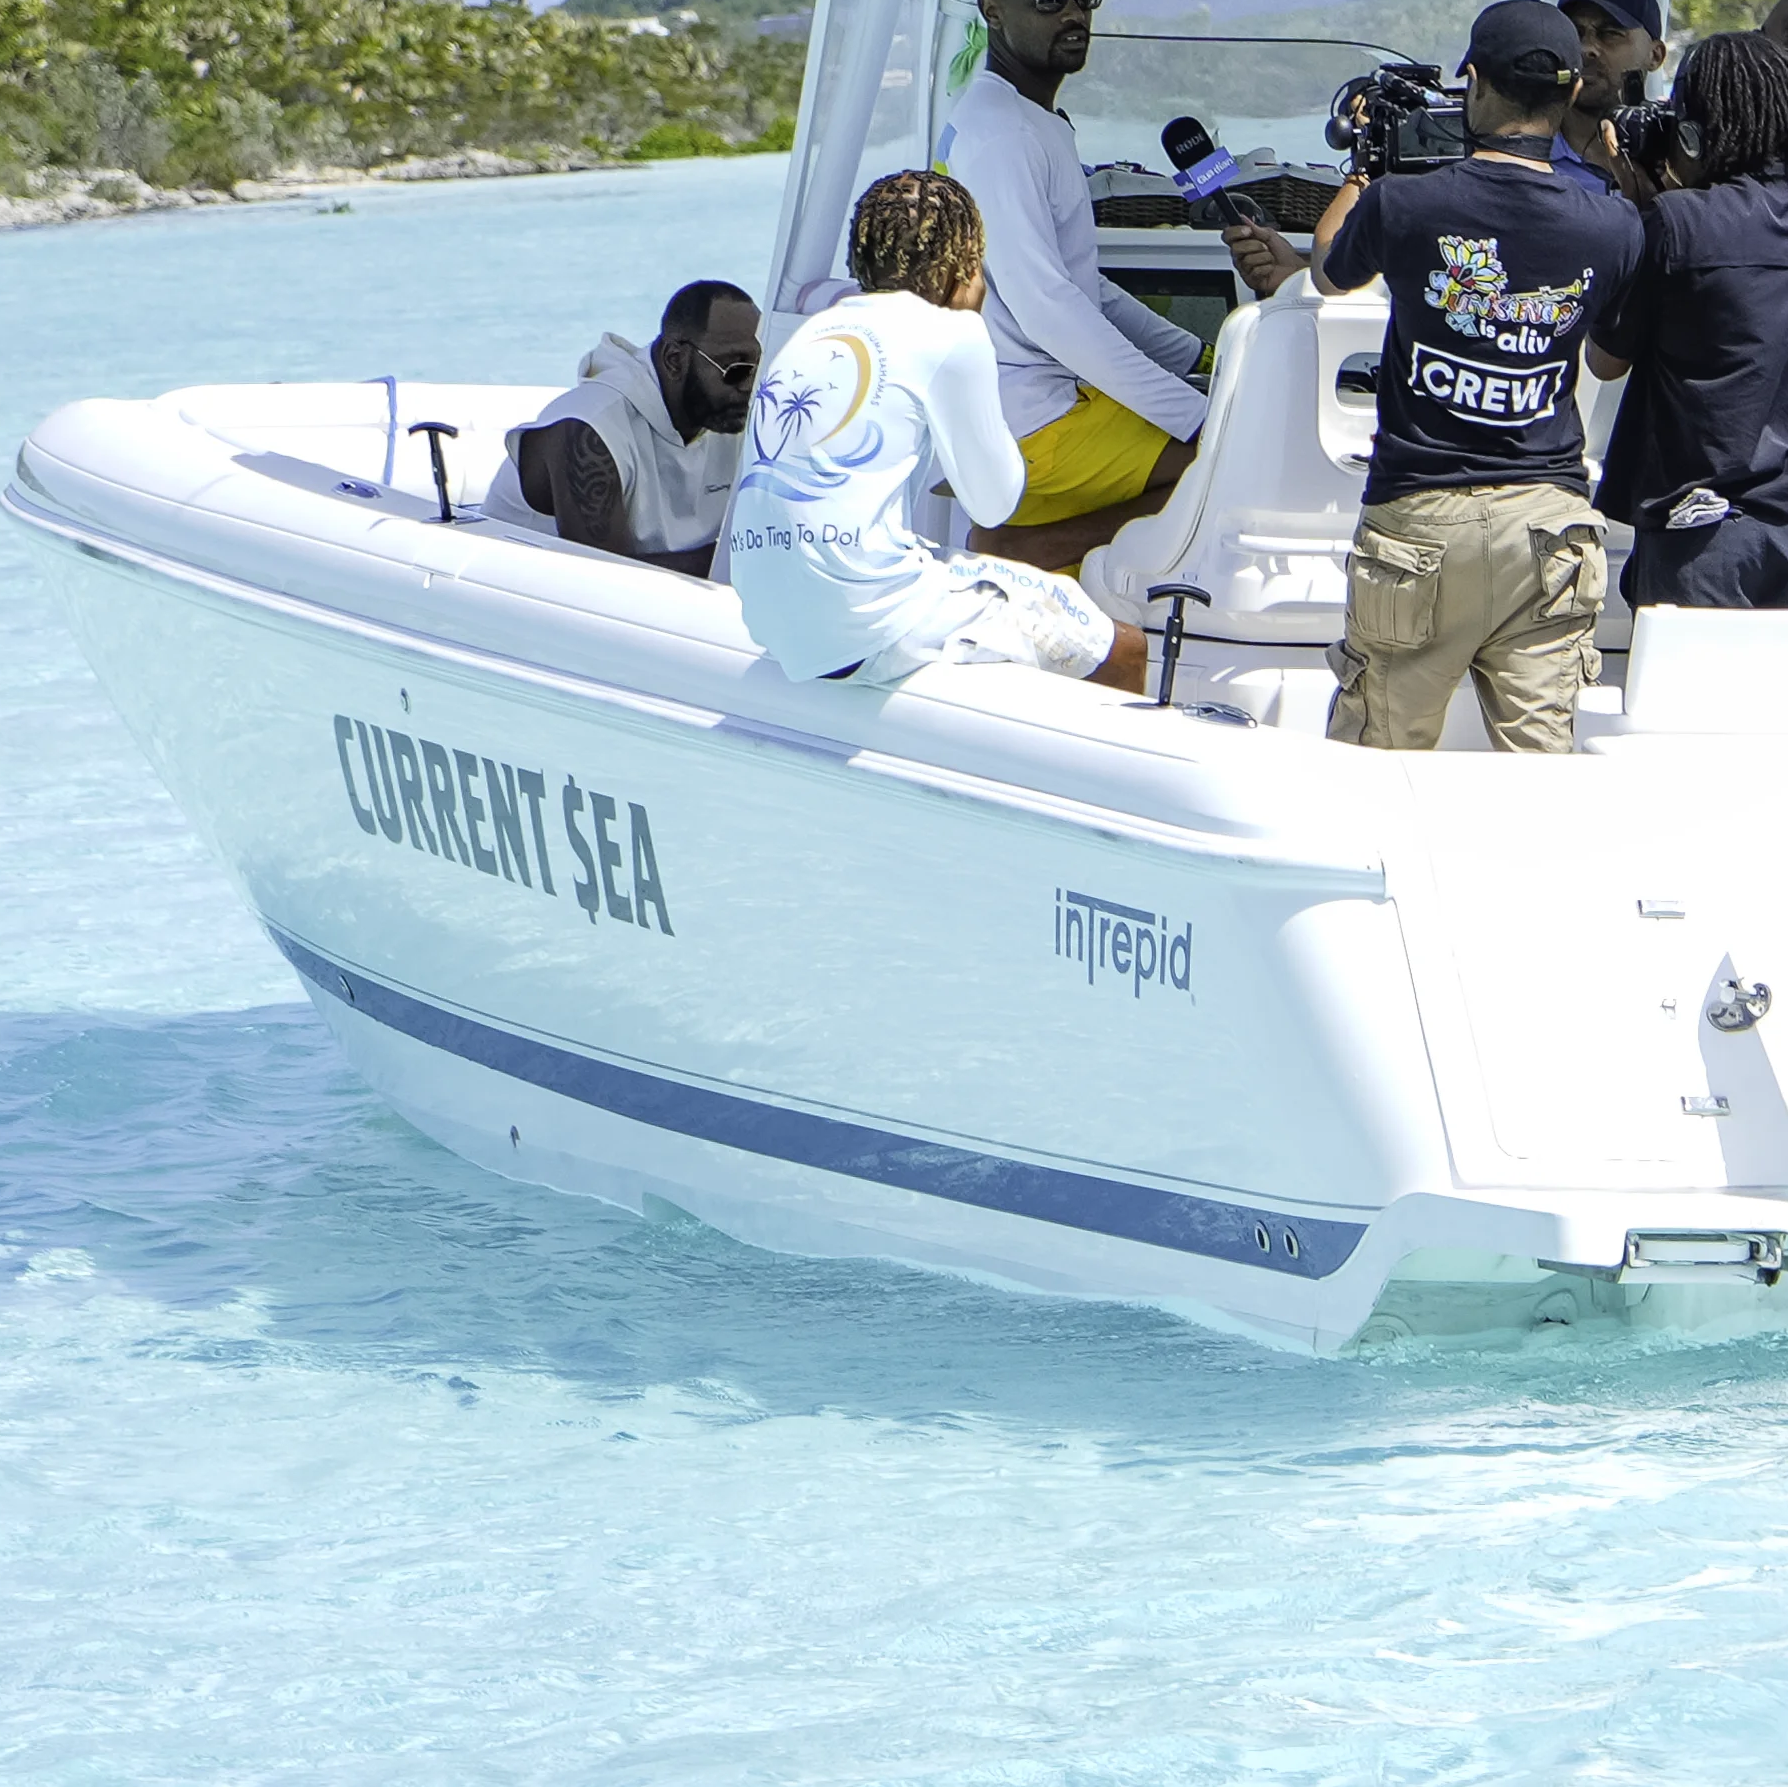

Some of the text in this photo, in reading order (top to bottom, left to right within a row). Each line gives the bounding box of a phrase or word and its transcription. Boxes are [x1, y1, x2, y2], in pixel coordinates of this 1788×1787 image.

[1480, 319, 1551, 354] is aliv
[870, 357, 888, 406] BAHAMAS
[1422, 361, 1548, 413] CREW
[746, 529, 763, 550] Da
[766, 526, 792, 550] Ting
[796, 523, 815, 543] To
[822, 524, 861, 547] Do!
[333, 714, 676, 937] CURRENT $EA
